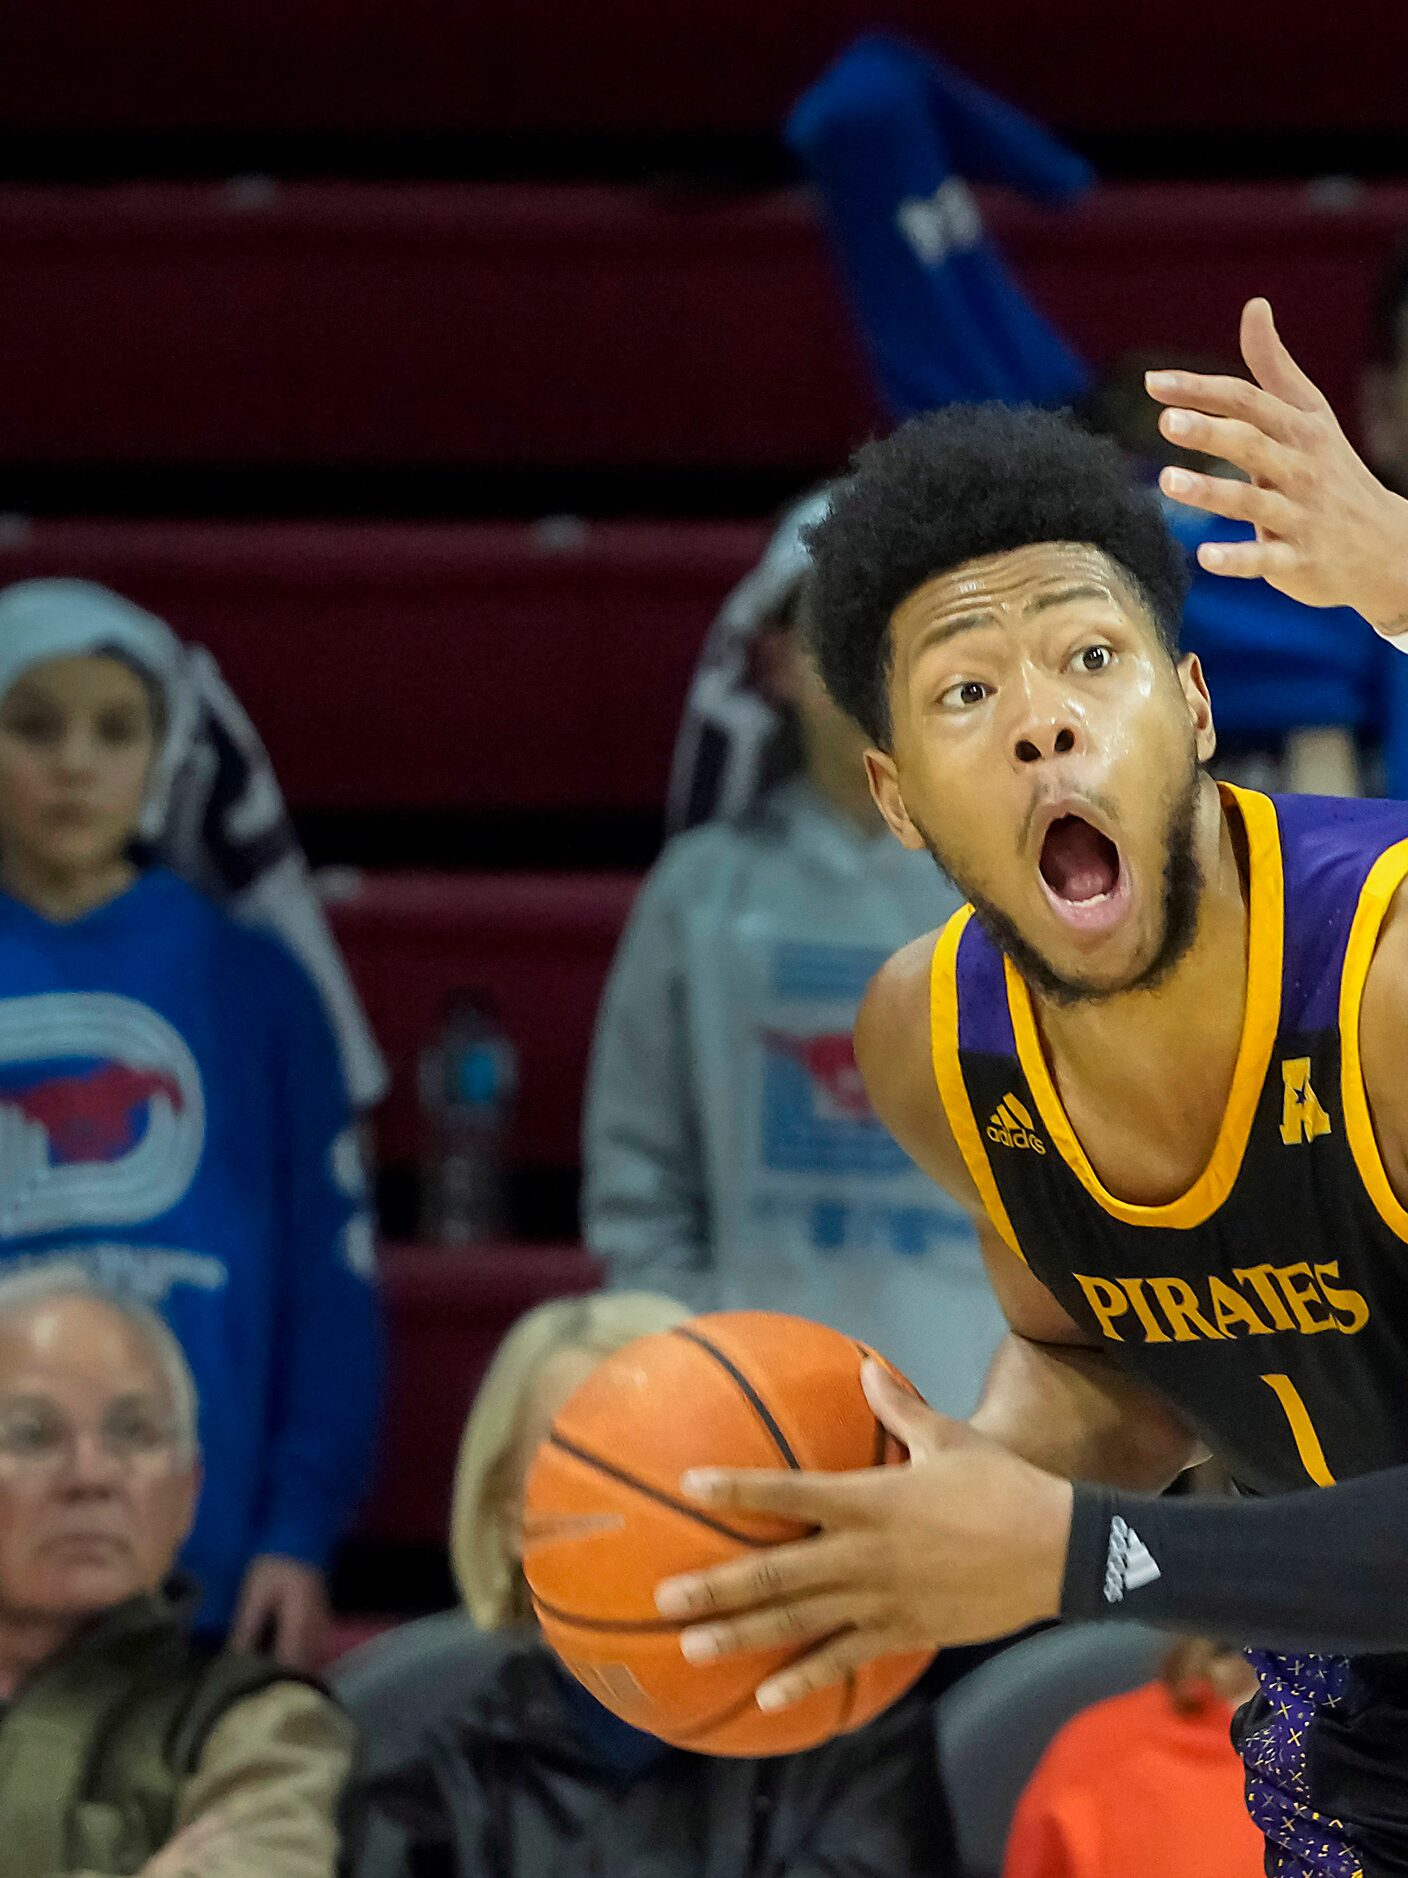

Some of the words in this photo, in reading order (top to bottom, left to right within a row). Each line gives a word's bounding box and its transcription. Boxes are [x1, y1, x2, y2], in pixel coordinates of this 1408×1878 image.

[986, 1125, 1047, 1156] adidas
[1072, 1260, 1371, 1345] PIRATES
[1259, 1373, 1337, 1489] 1
